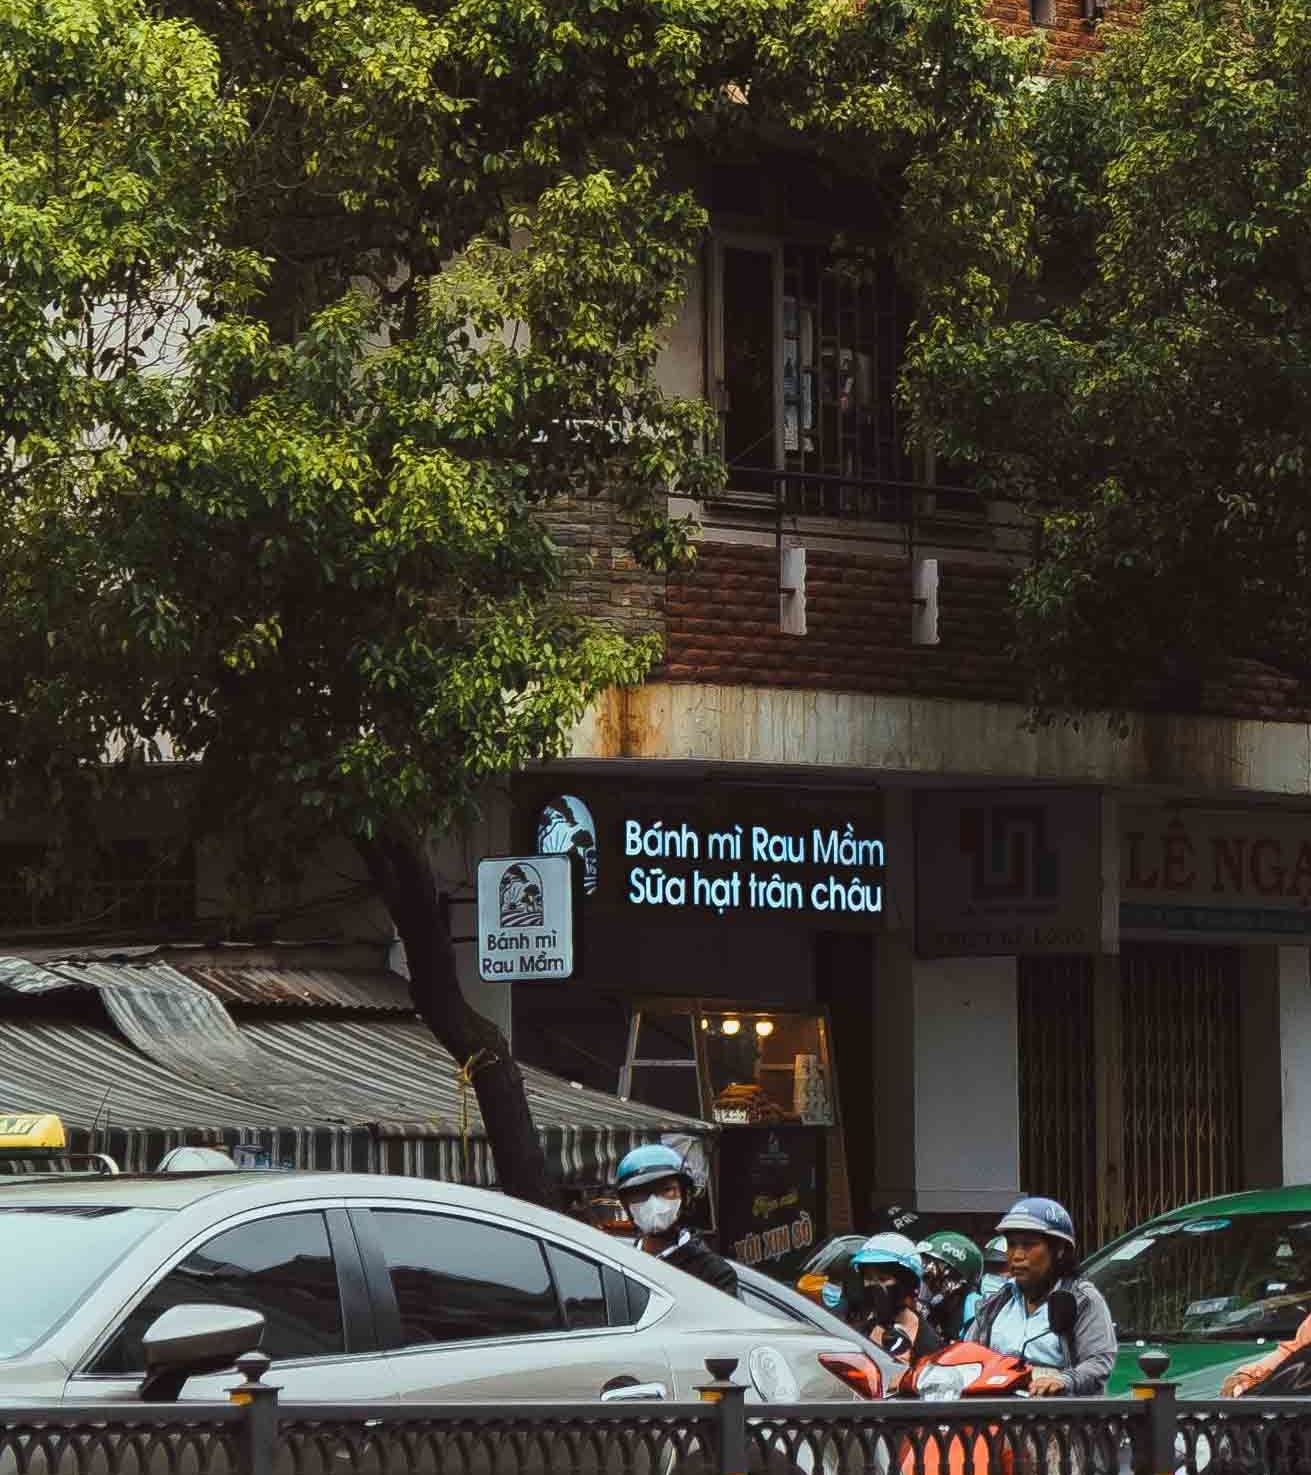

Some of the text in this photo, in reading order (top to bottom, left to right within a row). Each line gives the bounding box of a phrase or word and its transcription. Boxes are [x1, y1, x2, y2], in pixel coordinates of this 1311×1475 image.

[625, 820, 887, 867] Bánh mì Rau Mầm
[1123, 813, 1197, 890] LÊ
[629, 867, 883, 915] Sữa hạt trân châu
[486, 929, 559, 952] Bánh mì
[482, 953, 565, 976] Rau Mầm
[941, 1241, 968, 1262] Grab
